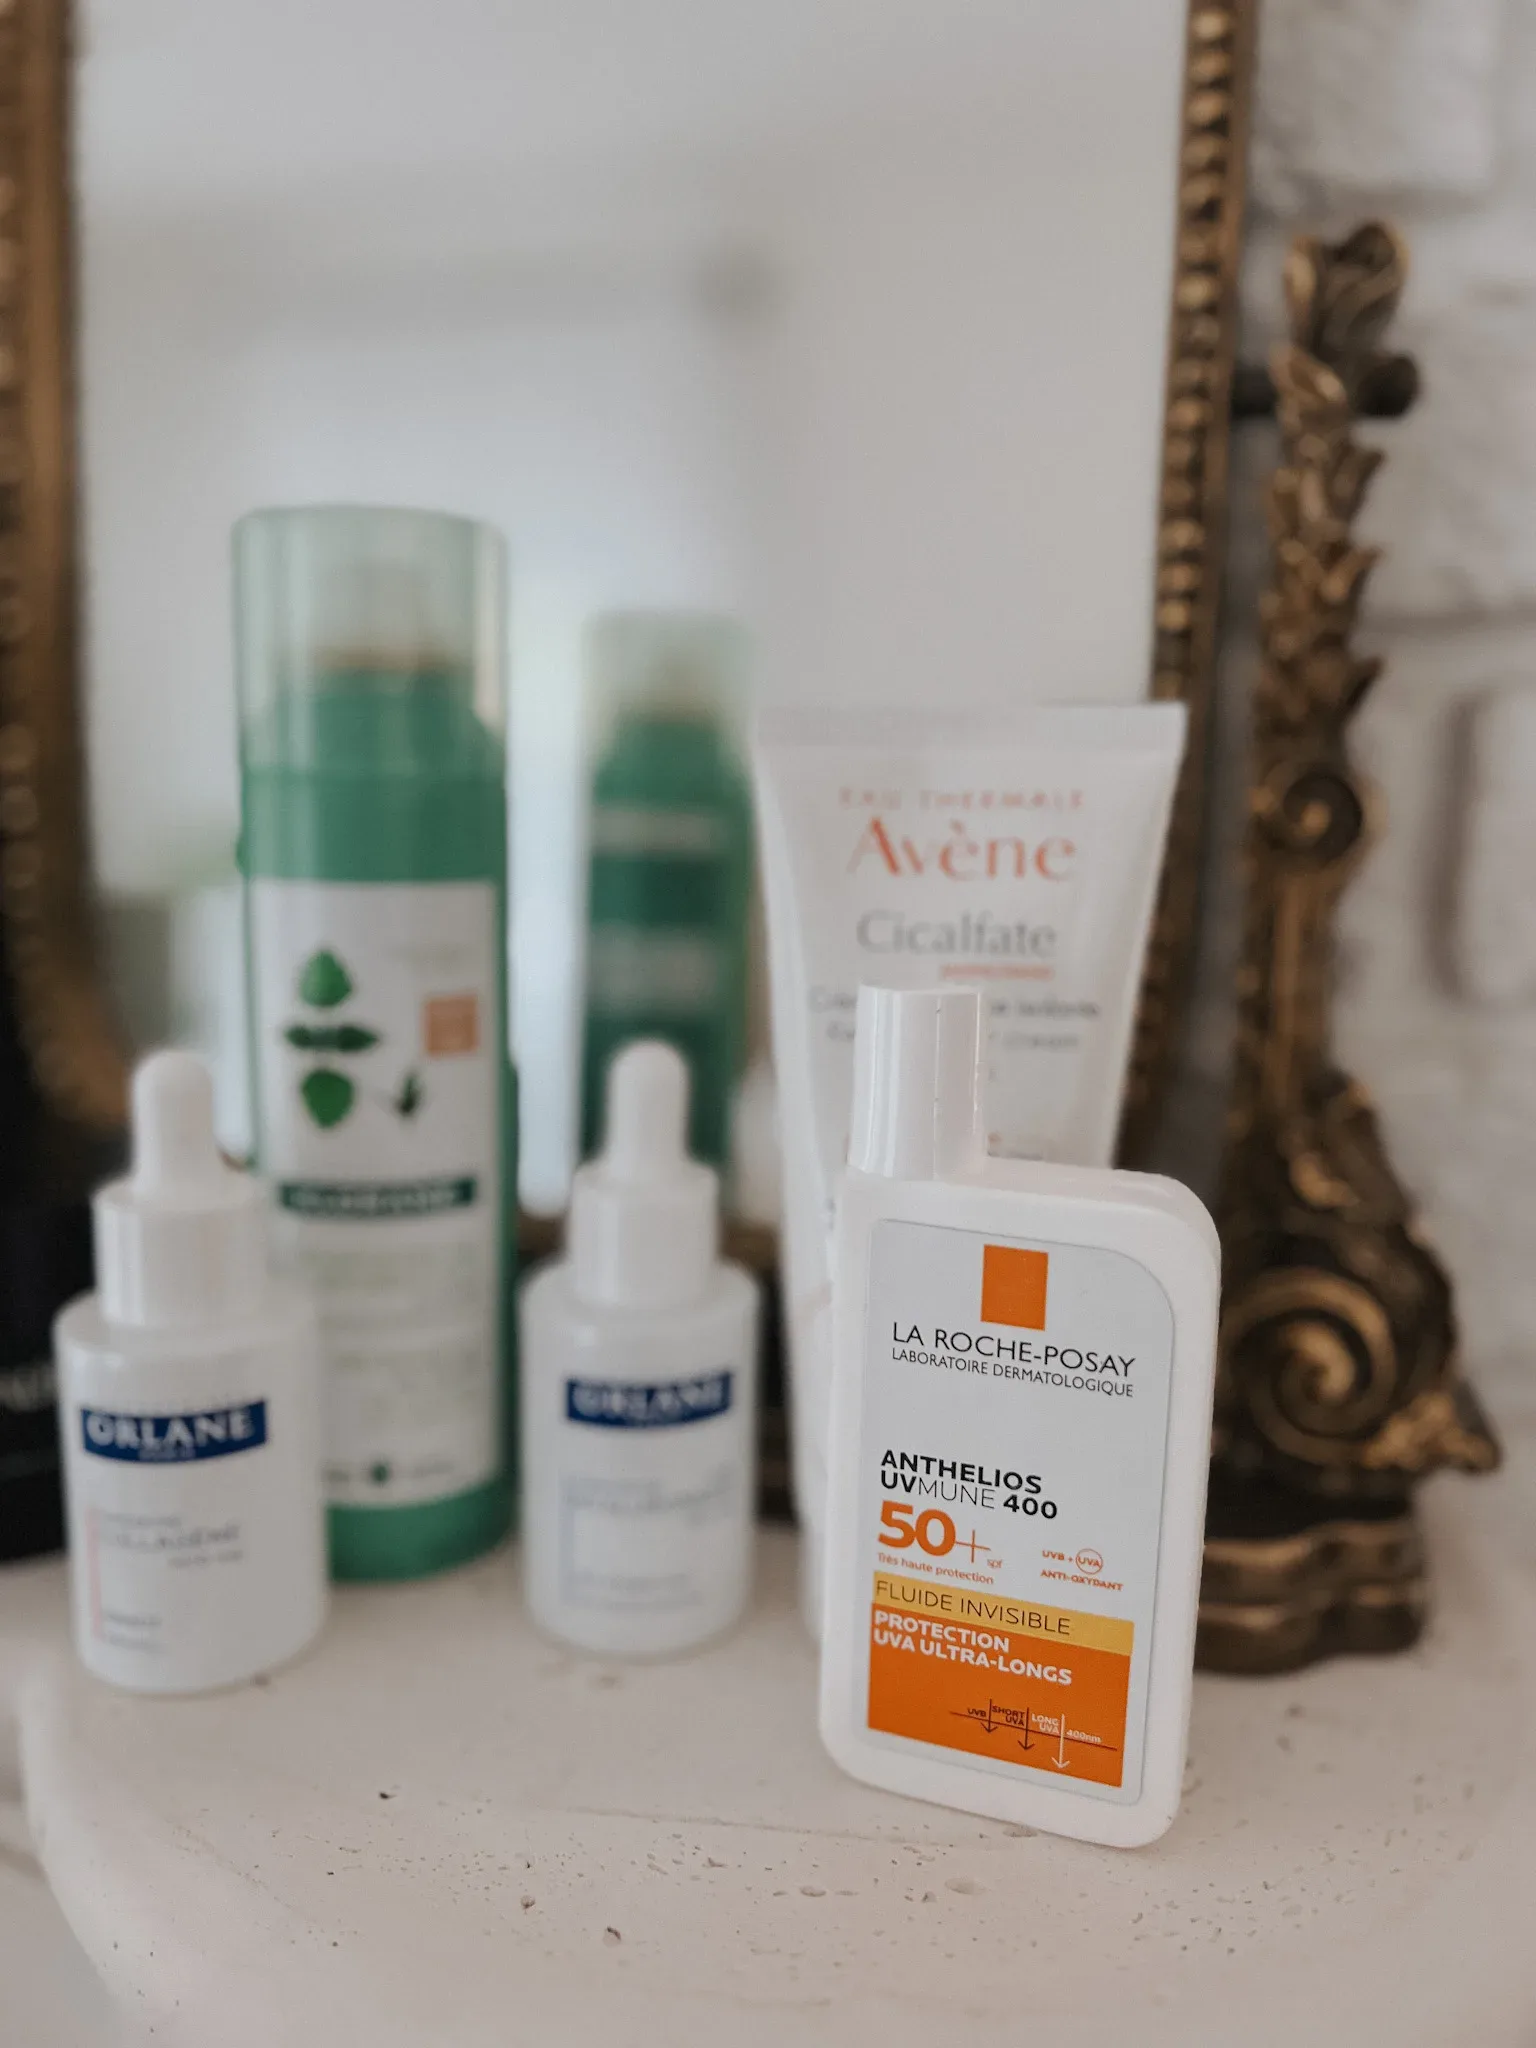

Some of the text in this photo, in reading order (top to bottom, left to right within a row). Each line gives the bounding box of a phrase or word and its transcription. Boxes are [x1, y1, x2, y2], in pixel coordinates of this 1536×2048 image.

[845, 815, 1077, 882] Avène
[855, 908, 1058, 957] Cicalfate
[893, 1321, 1136, 1378] LA ROCHE-POSAY
[892, 1347, 1134, 1398] LABORATOIRE DERMATOLOGIQUE
[86, 1408, 256, 1449] ORLANE
[881, 1449, 1043, 1495] ANTHELIOS
[881, 1470, 1059, 1520] UVMUNE 400
[877, 1500, 992, 1564] 50+
[876, 1552, 995, 1585] Très haute protection
[1040, 1569, 1124, 1591] ANTI-OXYDANT
[1042, 1549, 1066, 1562] UVB
[1077, 1555, 1102, 1569] UVA
[876, 1580, 1072, 1636] FLUIDE INVISIBLE
[874, 1609, 1010, 1653] PROTECTION
[873, 1629, 1073, 1686] UVA ULTRA-LONGS
[967, 1707, 987, 1718] UVB
[991, 1704, 1026, 1719] SHORT
[1005, 1715, 1025, 1727] UVA
[1031, 1713, 1059, 1727] LONG
[1039, 1723, 1060, 1735] UVA
[1066, 1729, 1102, 1744] 400nm
